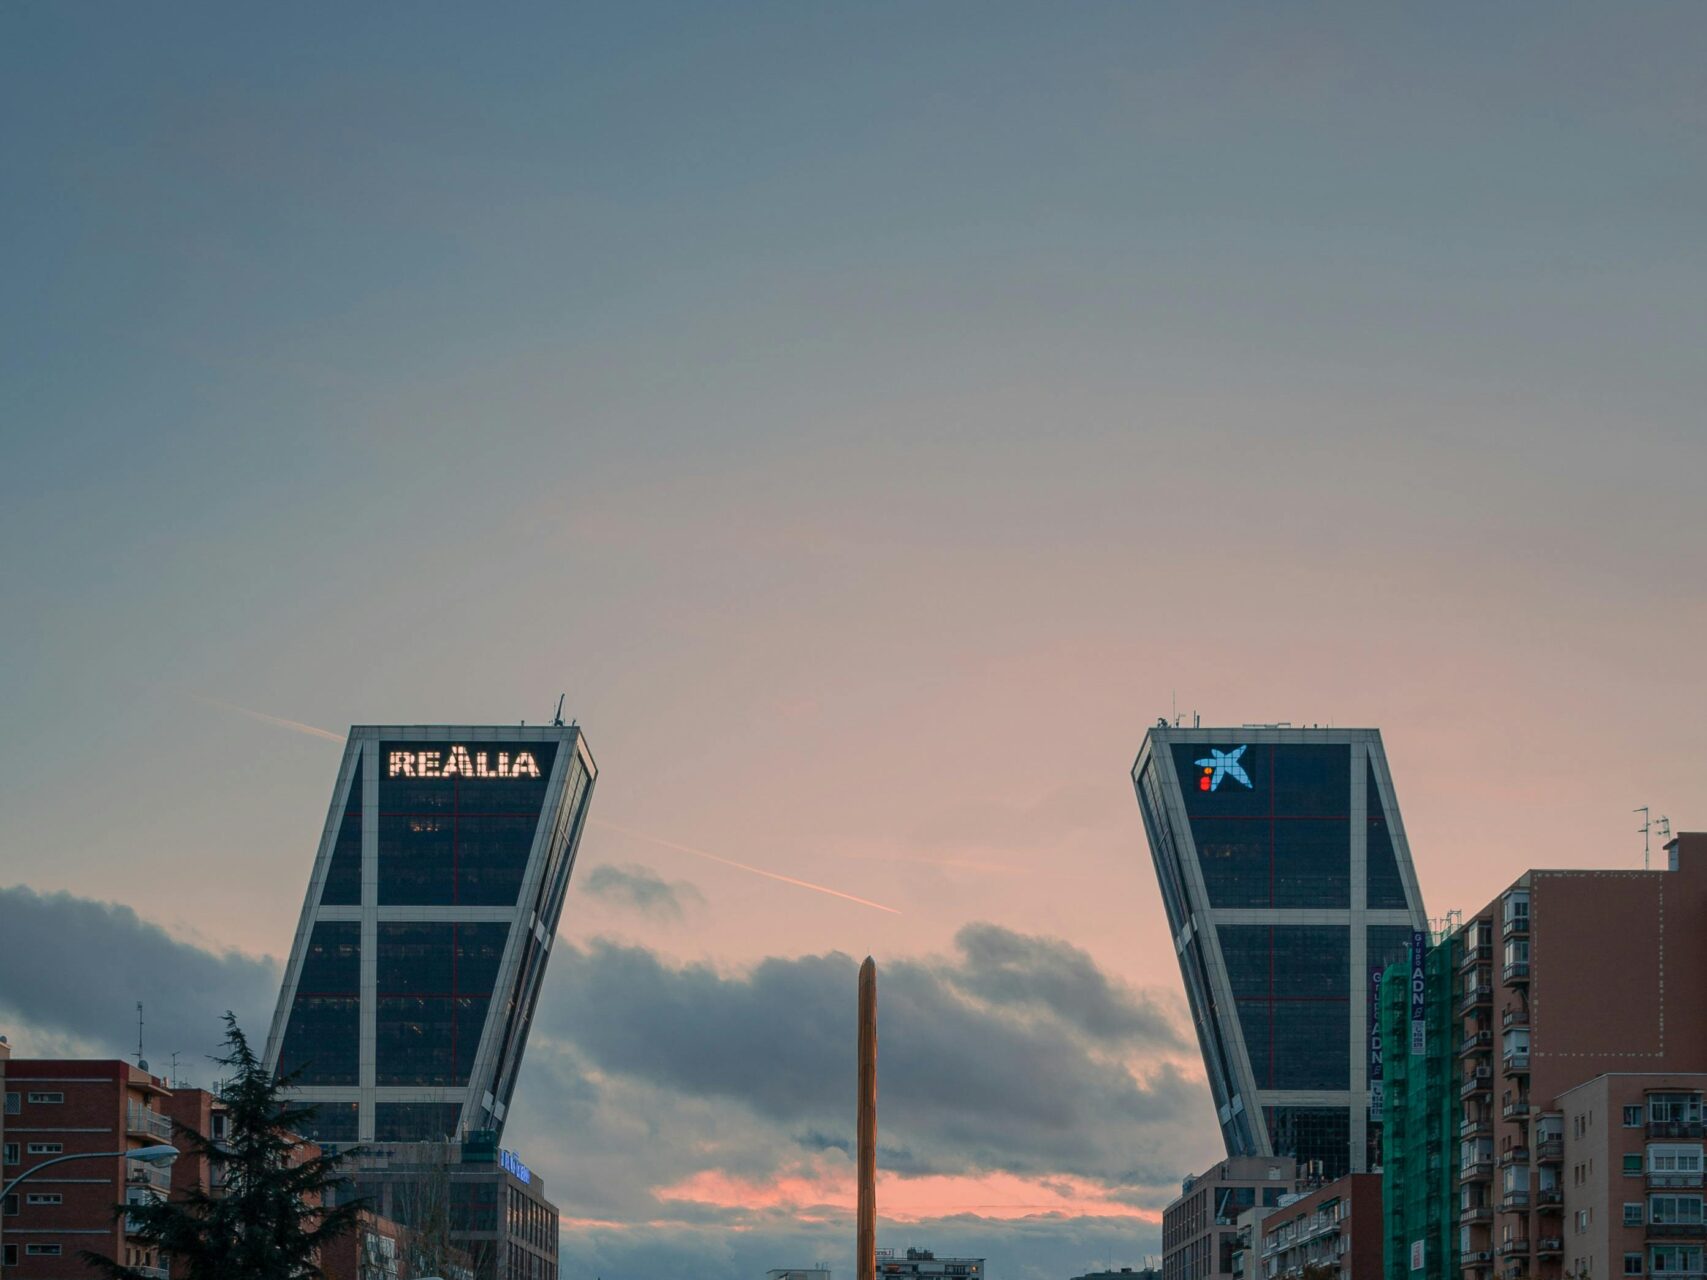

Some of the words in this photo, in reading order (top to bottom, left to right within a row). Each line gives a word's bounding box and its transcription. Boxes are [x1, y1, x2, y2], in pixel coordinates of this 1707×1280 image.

[389, 745, 542, 778] REALIA
[1414, 934, 1423, 967] Grupo
[1412, 967, 1425, 1005] ADN
[1371, 1023, 1383, 1064] ADN
